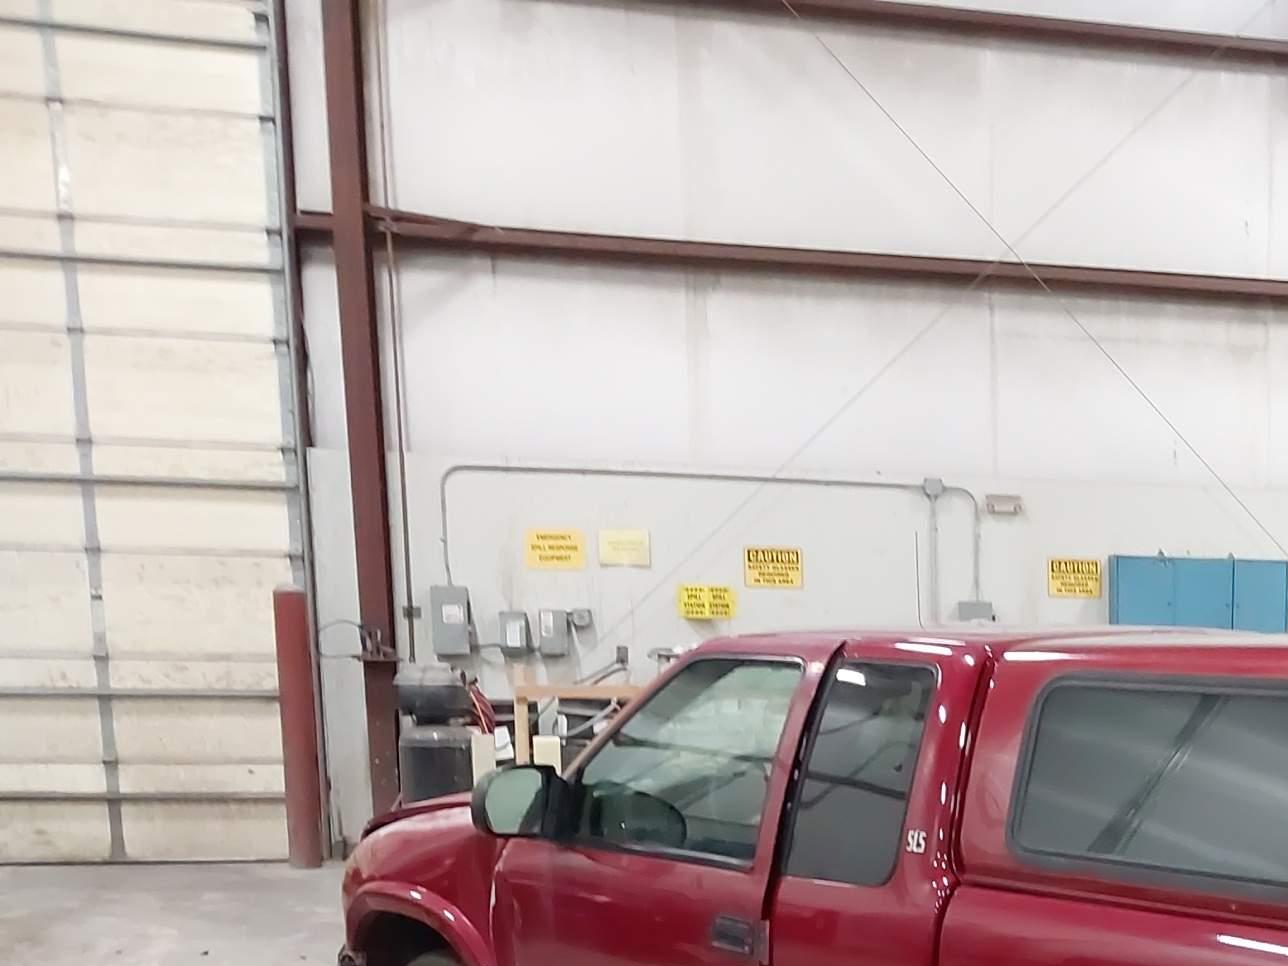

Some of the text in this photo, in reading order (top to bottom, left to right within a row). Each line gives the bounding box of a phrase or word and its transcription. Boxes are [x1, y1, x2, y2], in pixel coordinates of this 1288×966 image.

[748, 550, 798, 564] CAUTION
[1052, 560, 1097, 574] CAUTION
[906, 830, 927, 854] SLS
